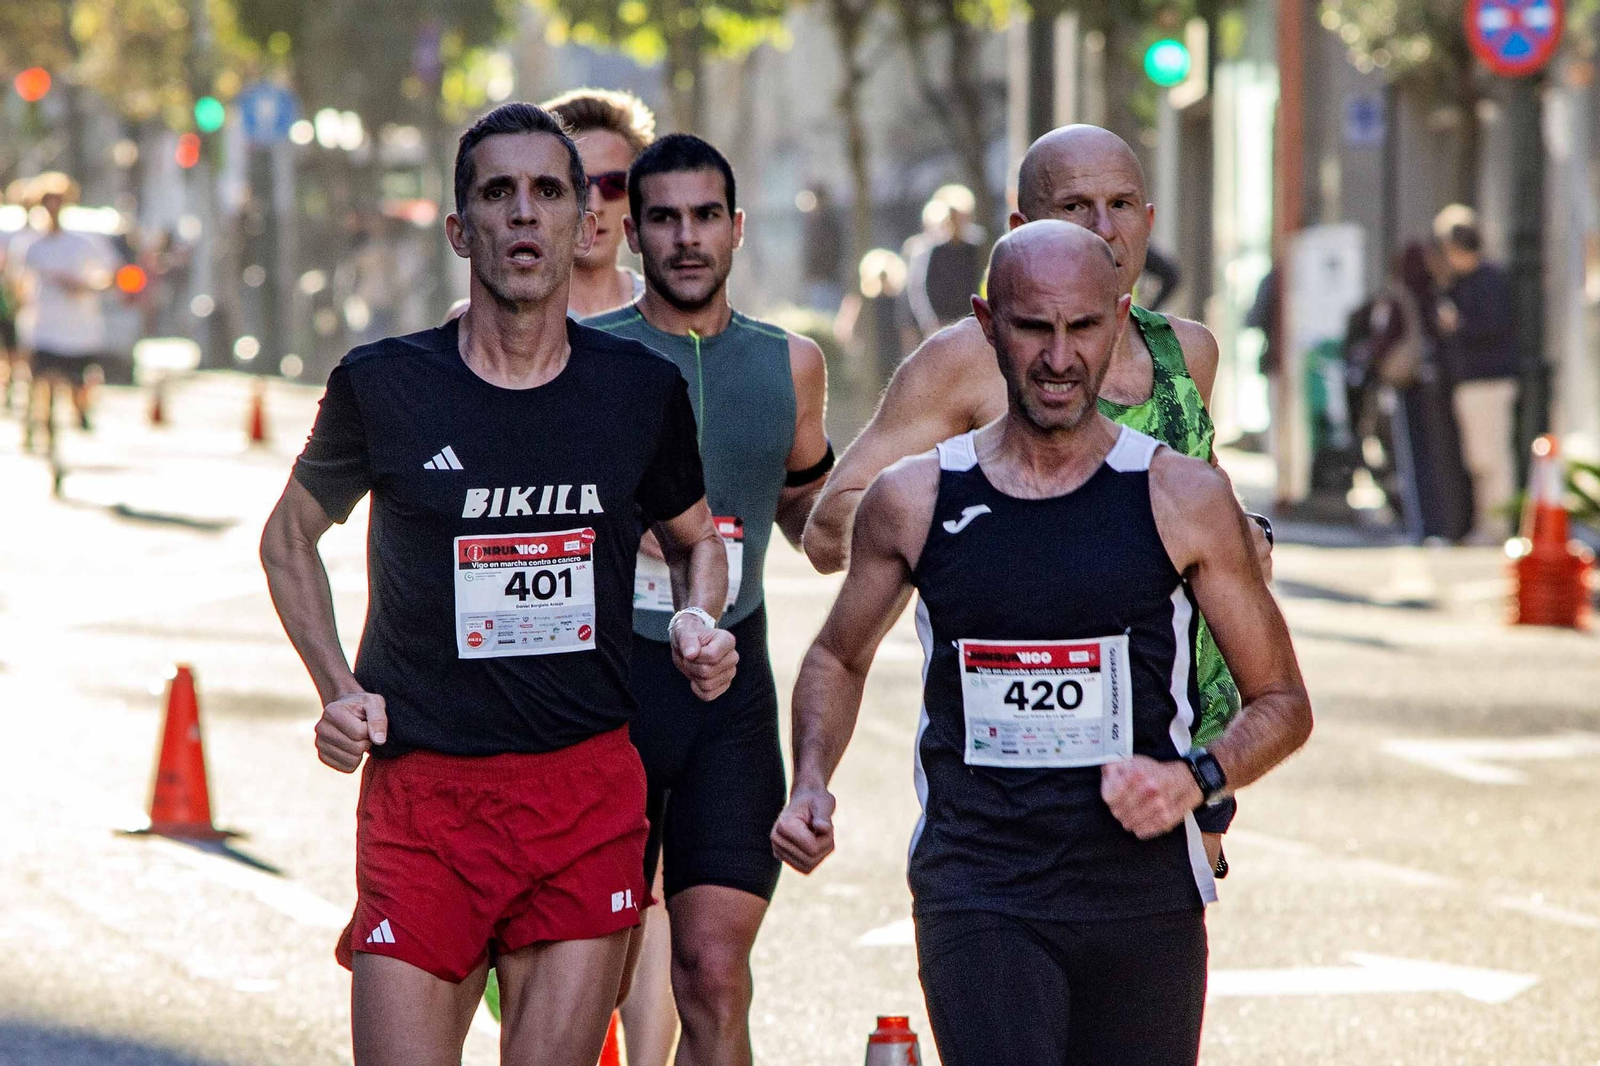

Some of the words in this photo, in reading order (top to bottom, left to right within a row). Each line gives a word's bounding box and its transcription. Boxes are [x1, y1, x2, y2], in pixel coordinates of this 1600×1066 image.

[462, 484, 604, 518] BIKILA
[471, 561, 488, 569] Vigo
[500, 559, 528, 568] marcha
[528, 558, 552, 567] contra
[505, 568, 572, 601] 401
[1004, 680, 1083, 711] 420
[611, 888, 639, 913] BI
